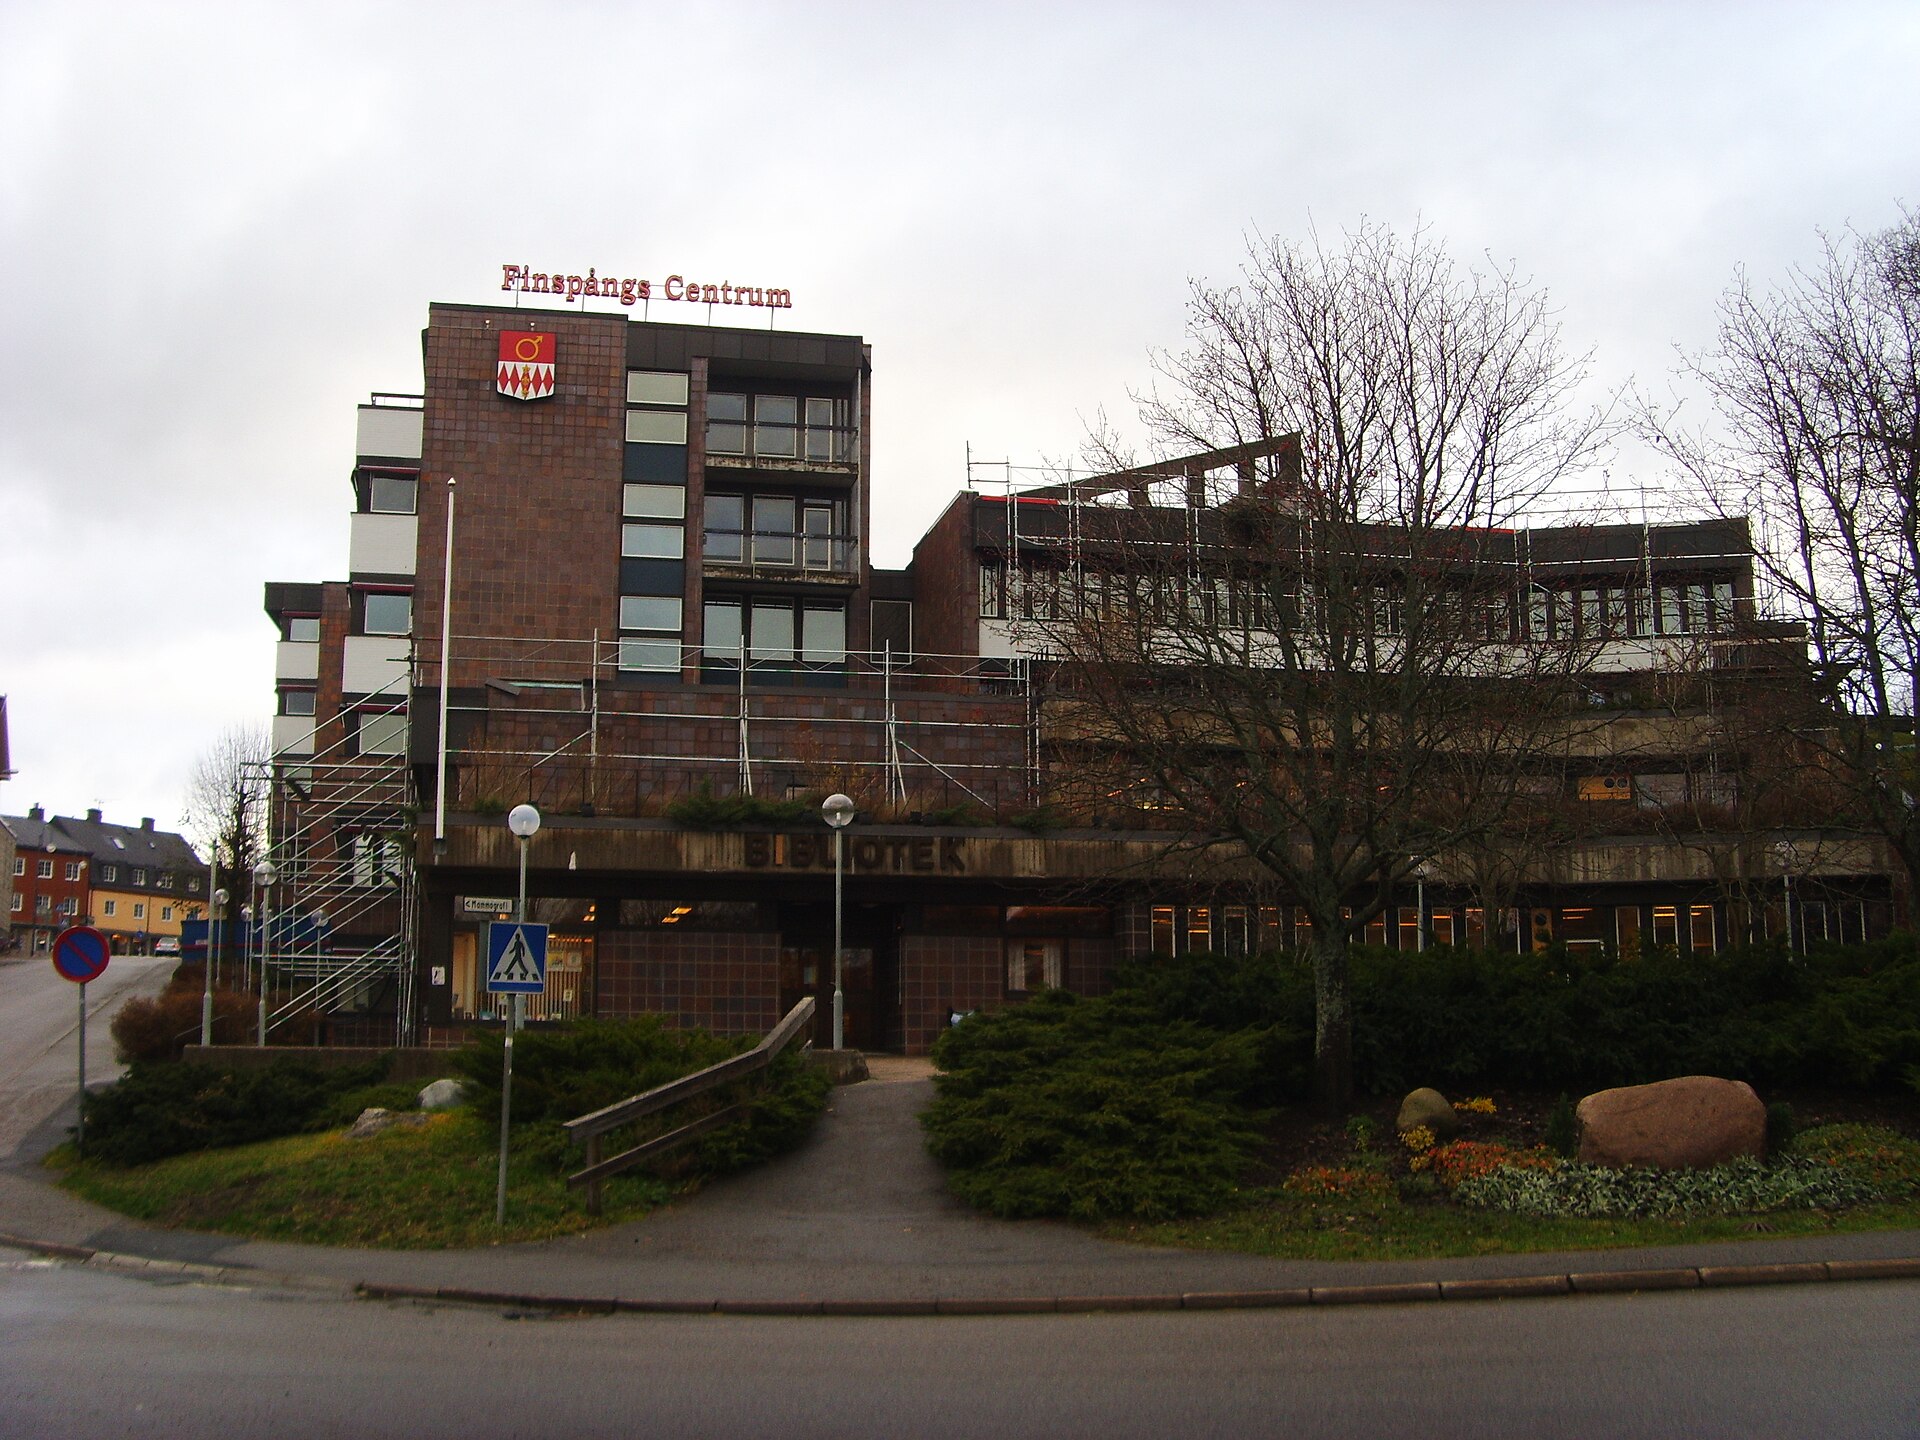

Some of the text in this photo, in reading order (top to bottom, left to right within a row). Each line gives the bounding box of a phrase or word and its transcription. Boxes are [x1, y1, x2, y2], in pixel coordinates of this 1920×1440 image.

[501, 264, 792, 308] Finspångs Centrum
[745, 832, 966, 871] BIBLIOTEK
